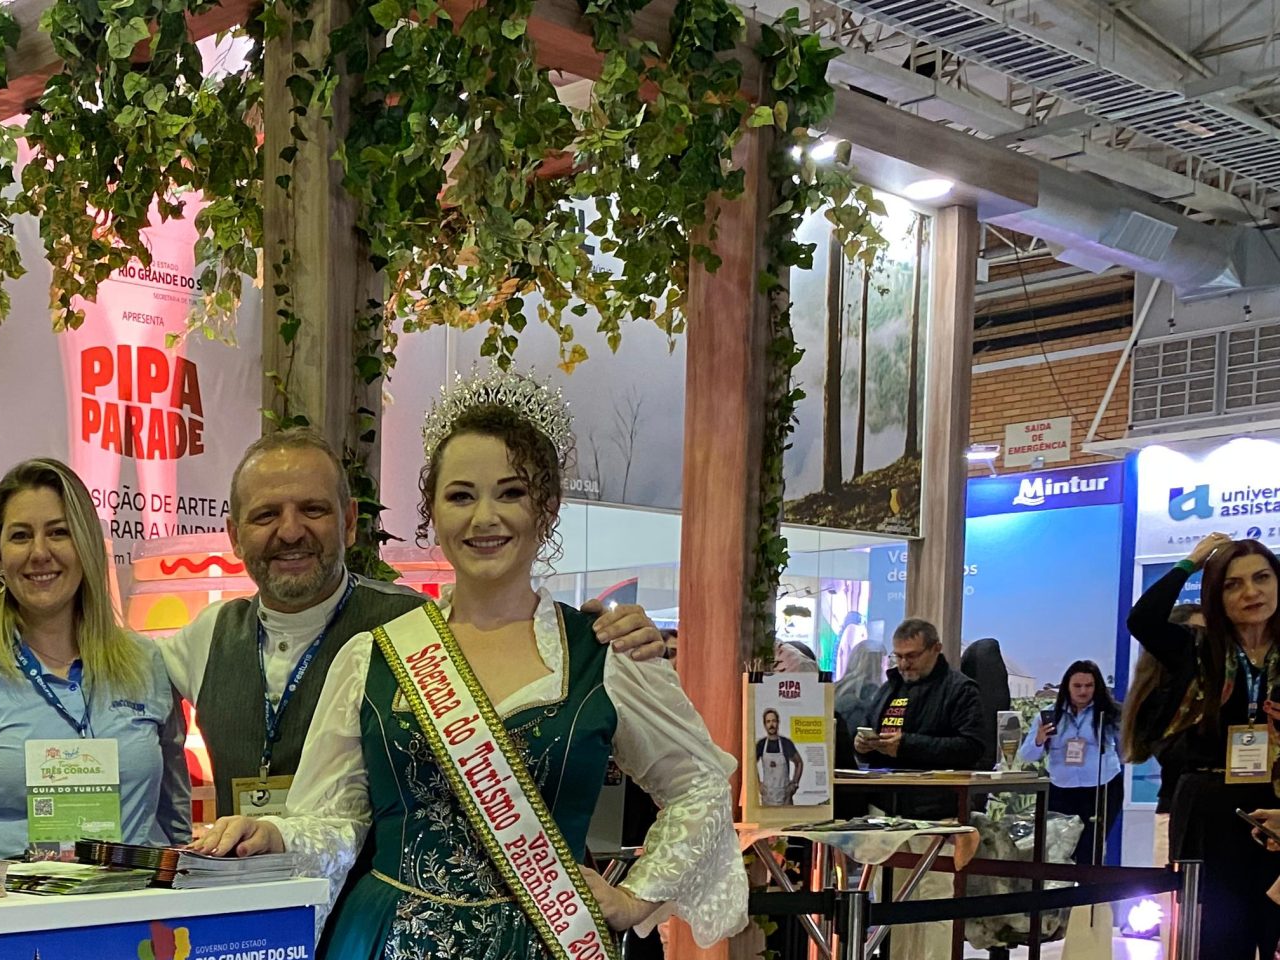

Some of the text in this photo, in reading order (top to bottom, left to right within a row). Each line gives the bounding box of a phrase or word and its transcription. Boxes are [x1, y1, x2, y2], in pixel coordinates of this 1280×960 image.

[118, 266, 136, 279] RIO
[138, 268, 178, 286] GRANDE
[180, 276, 195, 290] DO
[122, 311, 164, 327] APRESENTA
[81, 344, 204, 419] PIPA
[81, 396, 205, 461] PARADE
[1032, 433, 1044, 442] DE
[1008, 441, 1067, 455] EMERGÊNCIA
[584, 480, 600, 492] SUL
[1017, 476, 1109, 501] Mintur
[1222, 486, 1280, 503] univer
[92, 485, 146, 513] SIÇÃO
[151, 493, 172, 513] DE
[176, 496, 216, 518] ARTE
[1220, 499, 1280, 517] assista
[149, 522, 160, 540] A
[778, 680, 801, 690] PIPA
[405, 643, 521, 831] Soberana do Turismo
[41, 766, 100, 775] TRÊS COROAS
[527, 831, 578, 917] Vale do
[504, 834, 570, 936] Paranhana
[195, 938, 267, 954] GOVERNO DO ESTADO
[287, 945, 308, 960] SUL
